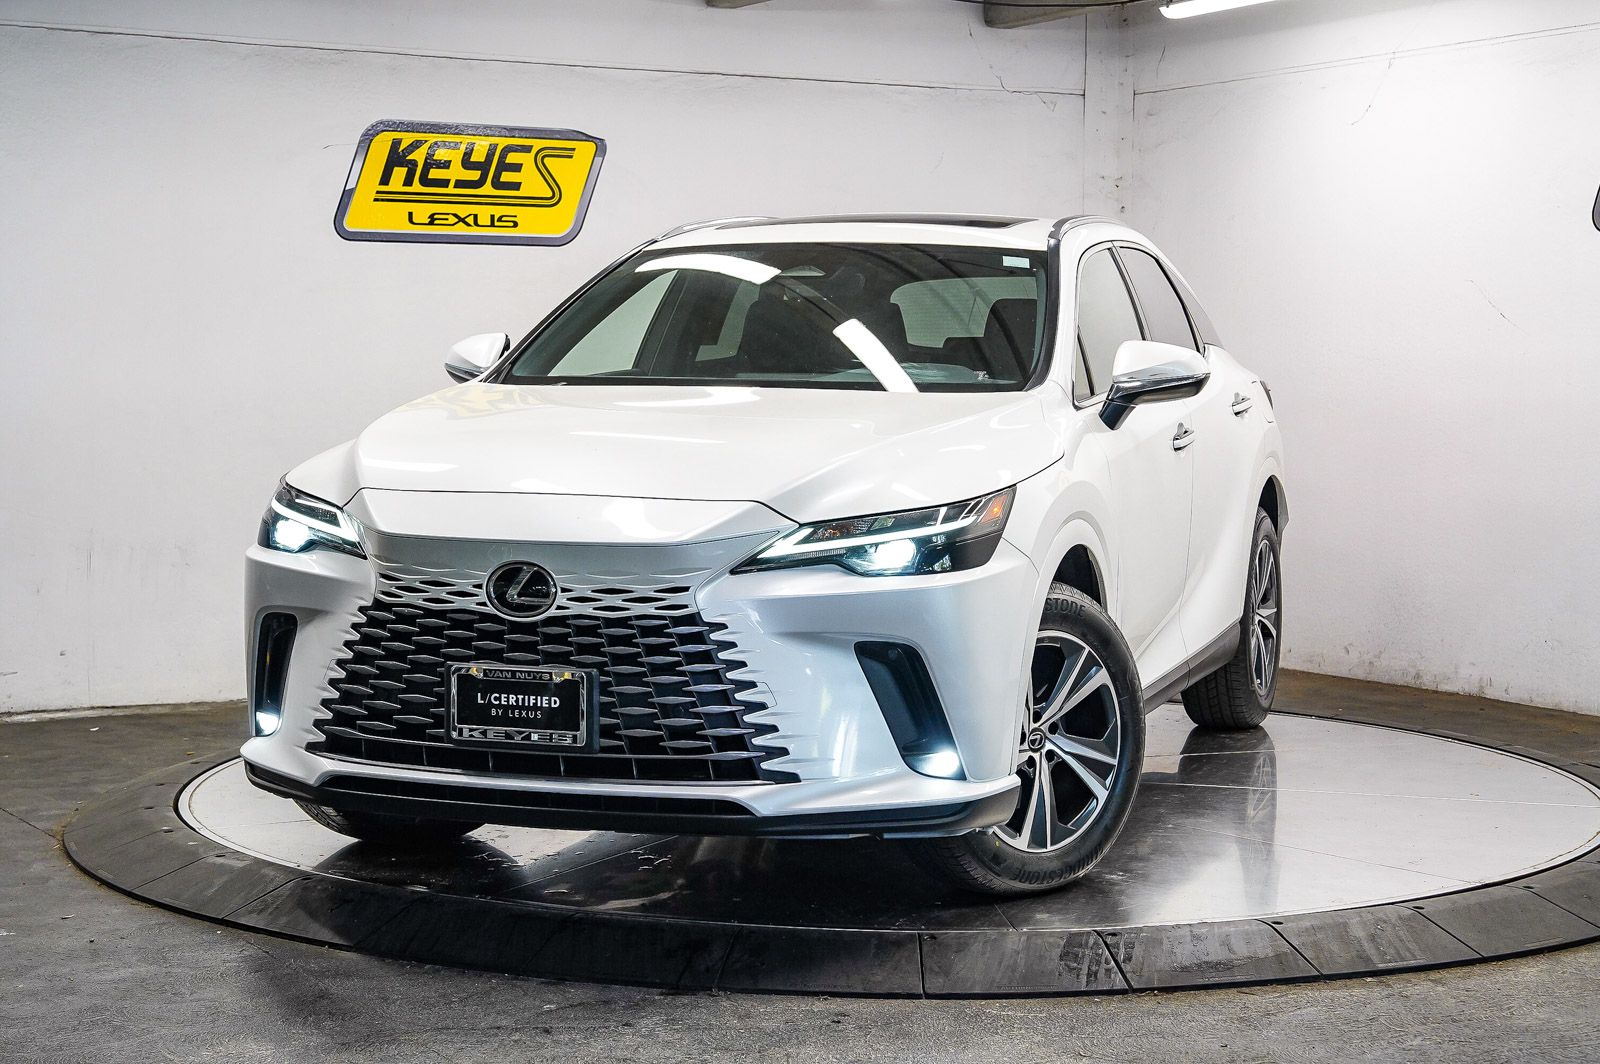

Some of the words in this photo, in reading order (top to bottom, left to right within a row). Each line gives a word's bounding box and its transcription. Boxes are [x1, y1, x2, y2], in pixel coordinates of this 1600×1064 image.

[408, 211, 519, 228] LEXUS
[486, 670, 512, 678] VAN
[516, 672, 551, 680] NUYS
[477, 692, 560, 708] L/CERTIFIED
[491, 708, 503, 716] BY
[508, 709, 542, 718] LEXUS
[462, 728, 573, 744] KEYES
